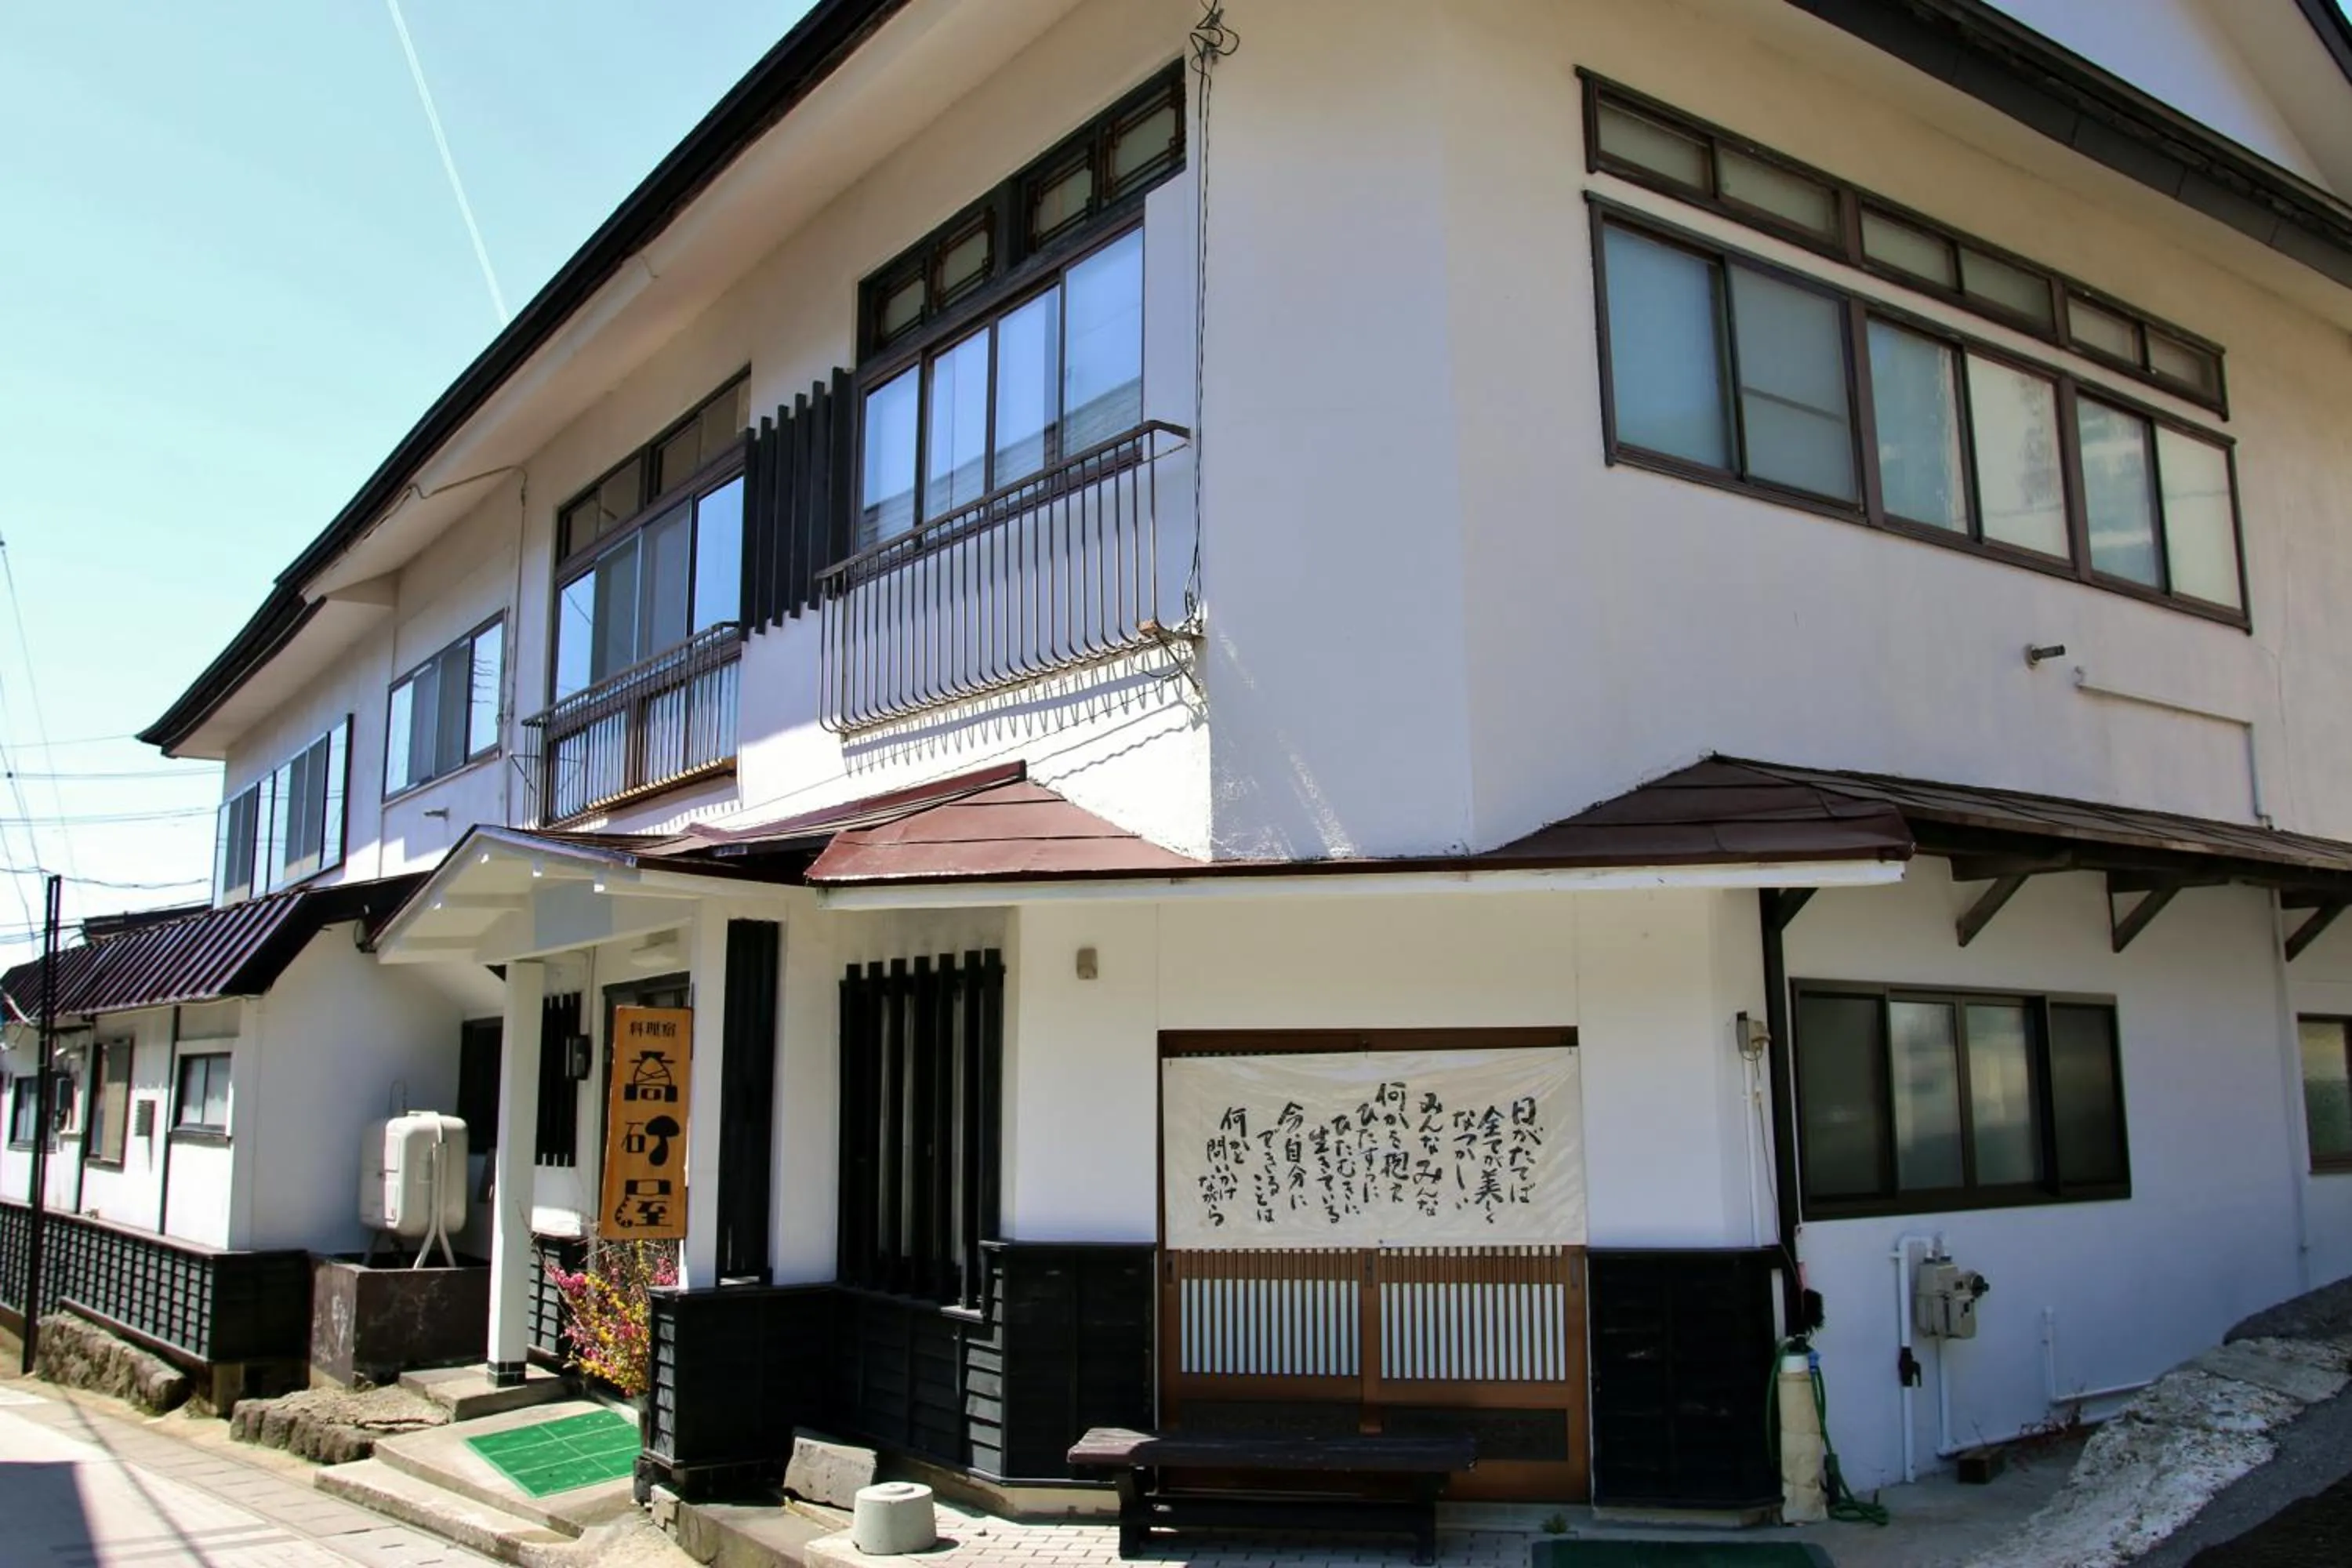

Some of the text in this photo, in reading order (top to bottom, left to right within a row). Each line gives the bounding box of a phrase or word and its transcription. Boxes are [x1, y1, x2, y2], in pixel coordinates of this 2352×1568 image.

[629, 1021, 676, 1037] 料理宿
[1413, 1092, 1443, 1217] みんなみんな
[1453, 1109, 1477, 1210] なつかしい
